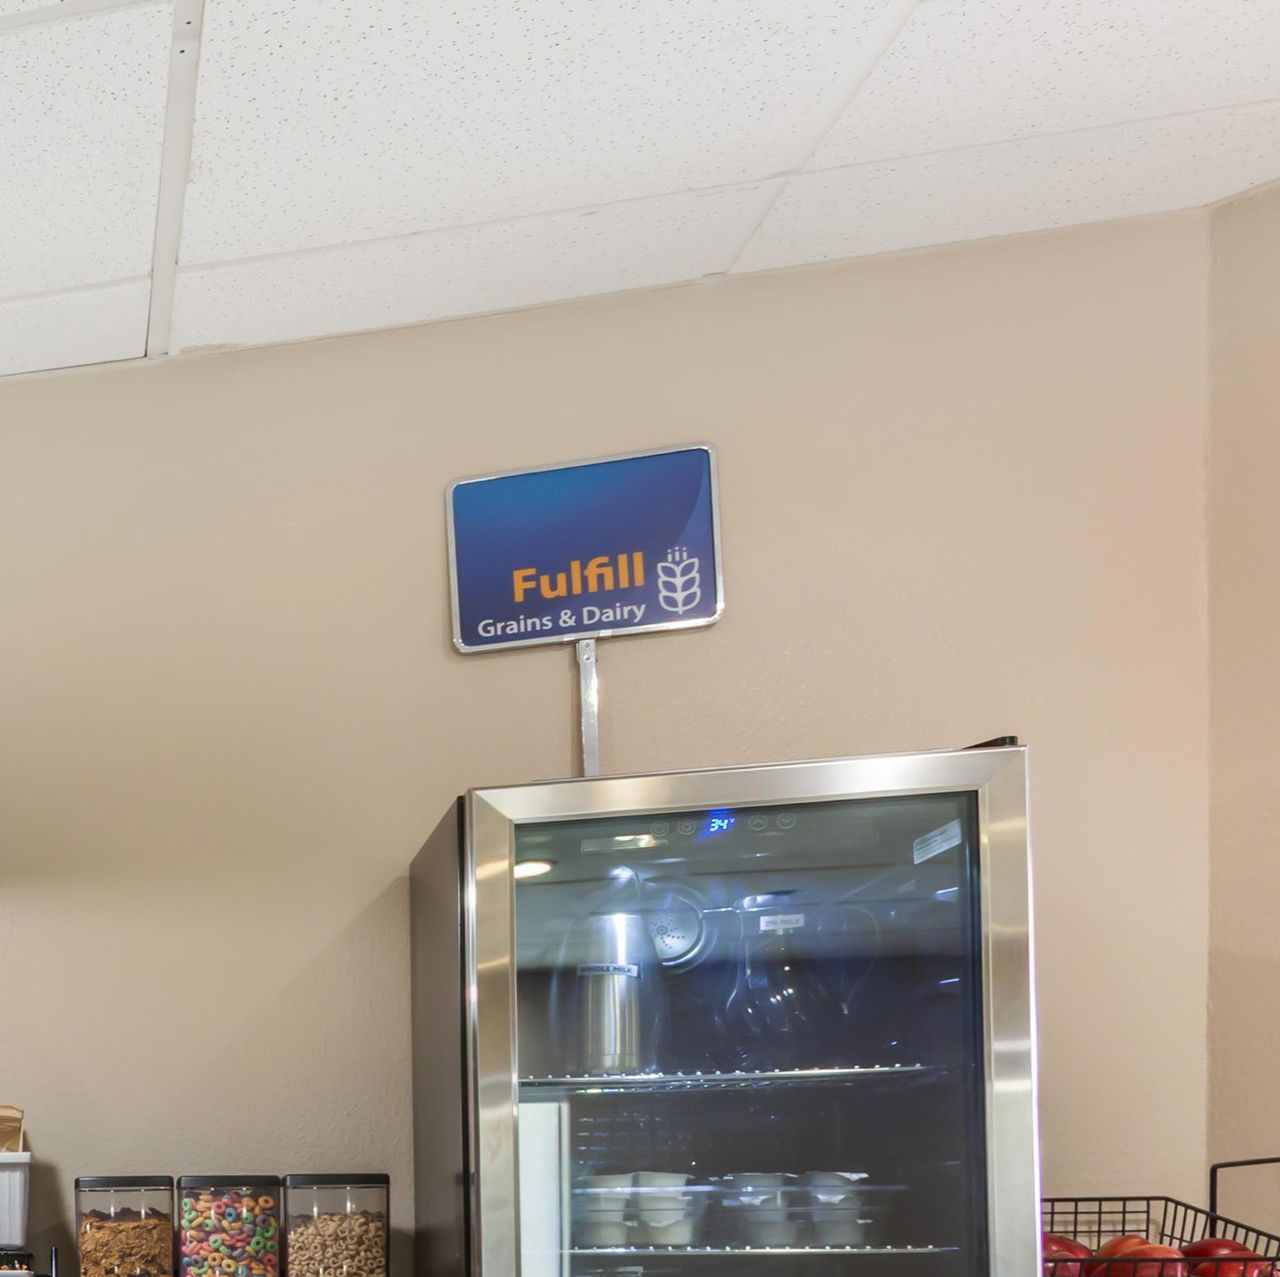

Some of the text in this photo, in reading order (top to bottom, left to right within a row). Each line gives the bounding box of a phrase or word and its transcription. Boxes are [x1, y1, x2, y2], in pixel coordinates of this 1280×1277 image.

[512, 551, 646, 603] Fulfill
[477, 602, 647, 637] Grains & Dairy
[709, 818, 729, 832] 34
[612, 966, 633, 974] MILK
